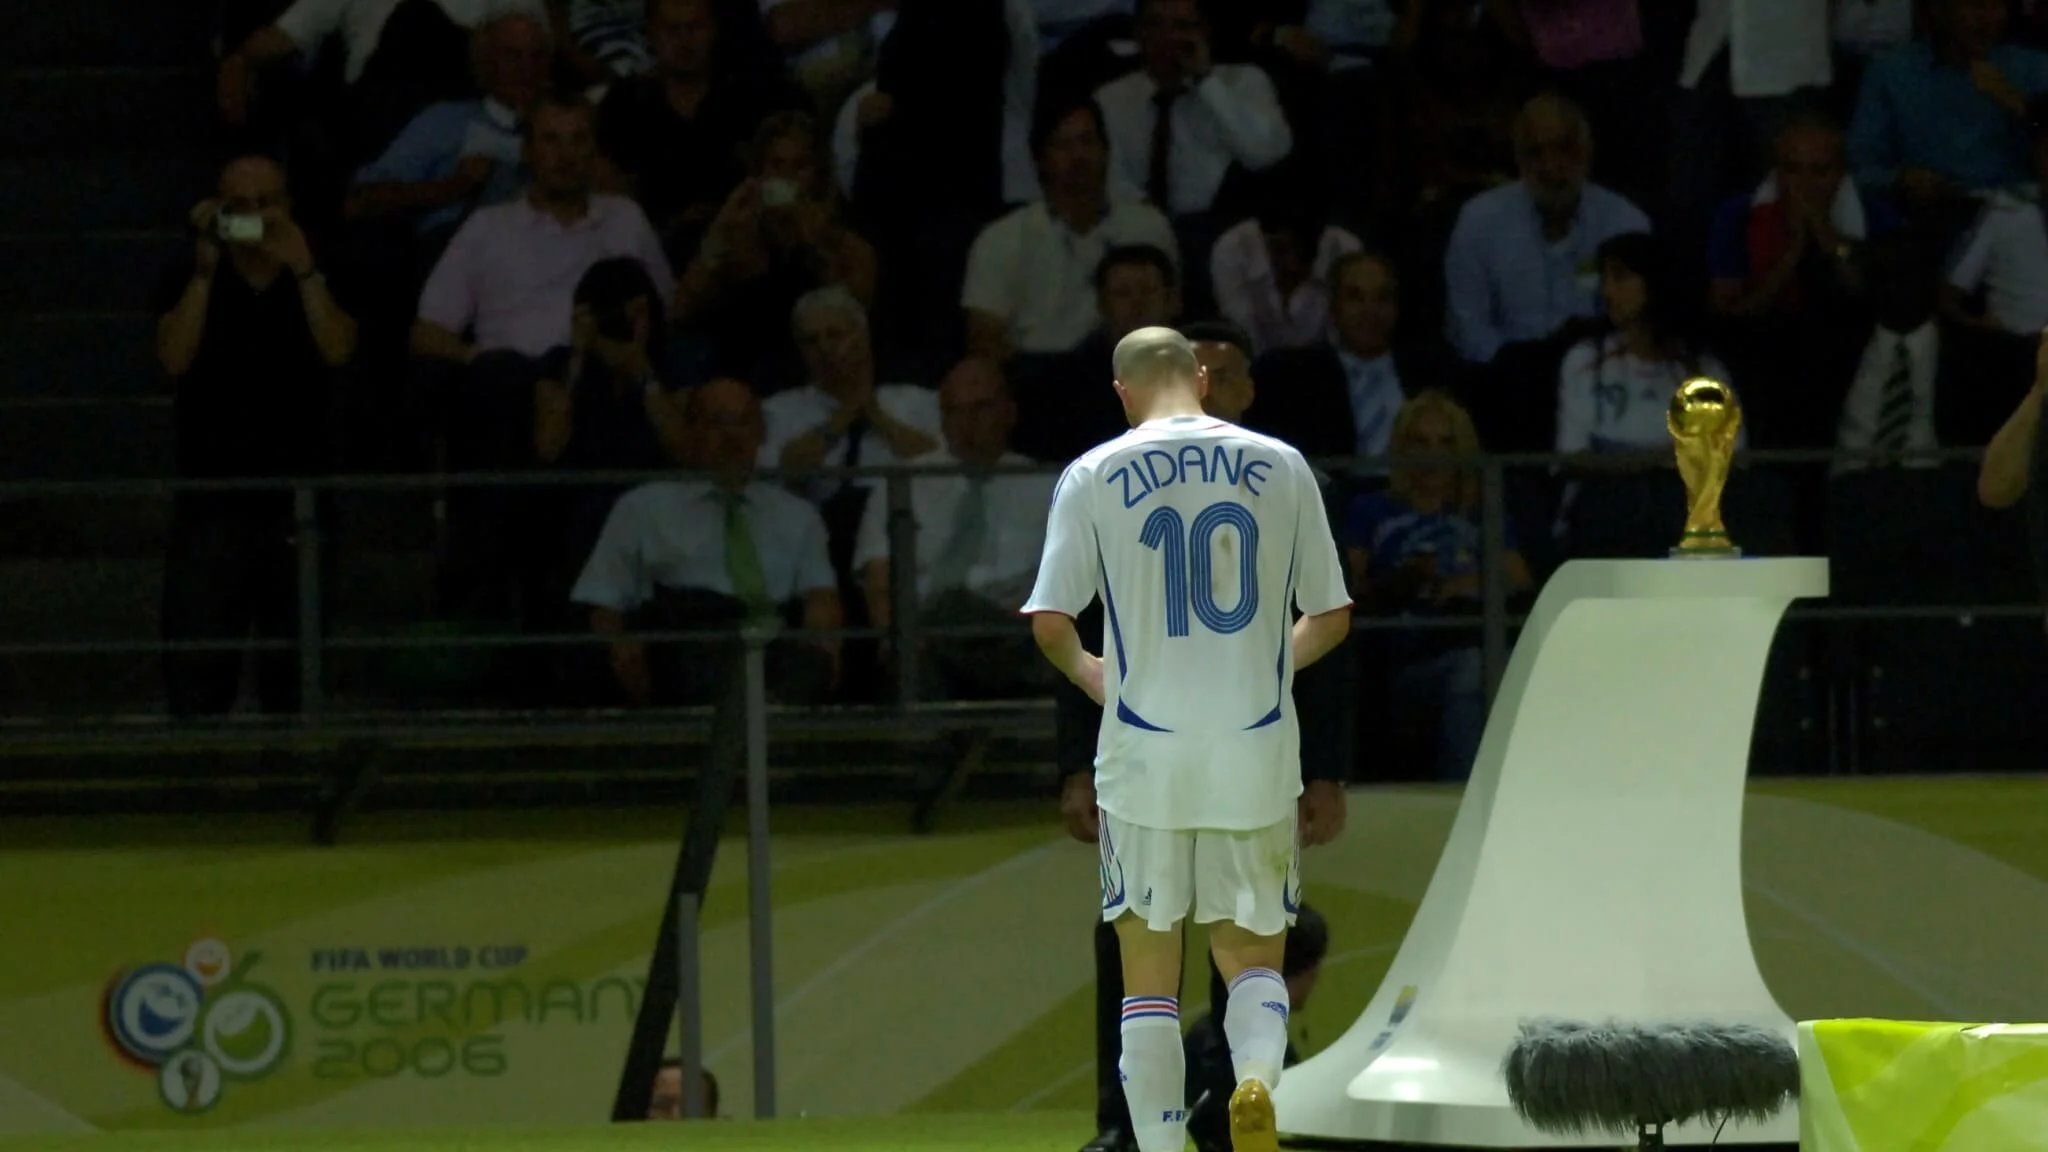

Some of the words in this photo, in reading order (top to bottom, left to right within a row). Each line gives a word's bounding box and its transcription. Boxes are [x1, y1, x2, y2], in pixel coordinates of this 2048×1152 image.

[1107, 446, 1272, 508] ZIDANE
[1139, 502, 1259, 637] 10
[311, 949, 370, 971] FIFA
[379, 949, 470, 970] WORLD
[478, 946, 527, 967] CUP
[311, 978, 647, 1028] GERMAN
[312, 1036, 507, 1078] 2006
